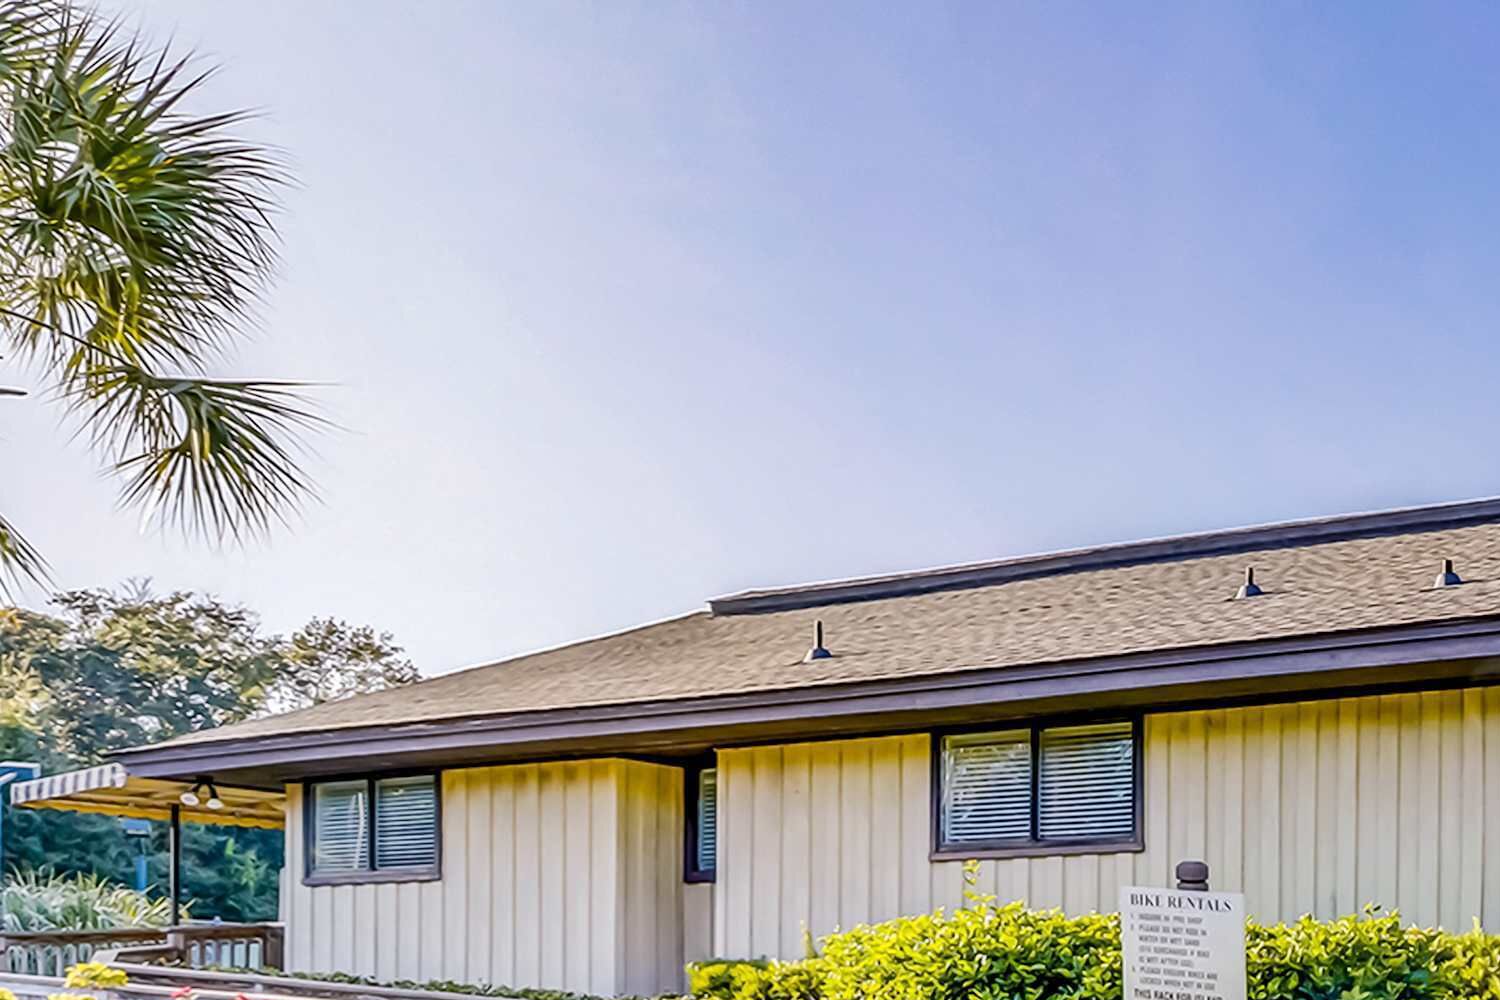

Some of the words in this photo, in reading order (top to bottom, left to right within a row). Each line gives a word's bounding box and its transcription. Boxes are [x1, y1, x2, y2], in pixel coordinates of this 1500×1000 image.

[1130, 894, 1160, 906] BIKE
[1167, 895, 1232, 912] RENTALS
[1134, 988, 1151, 999] THIS
[1154, 990, 1174, 1000] RACK
